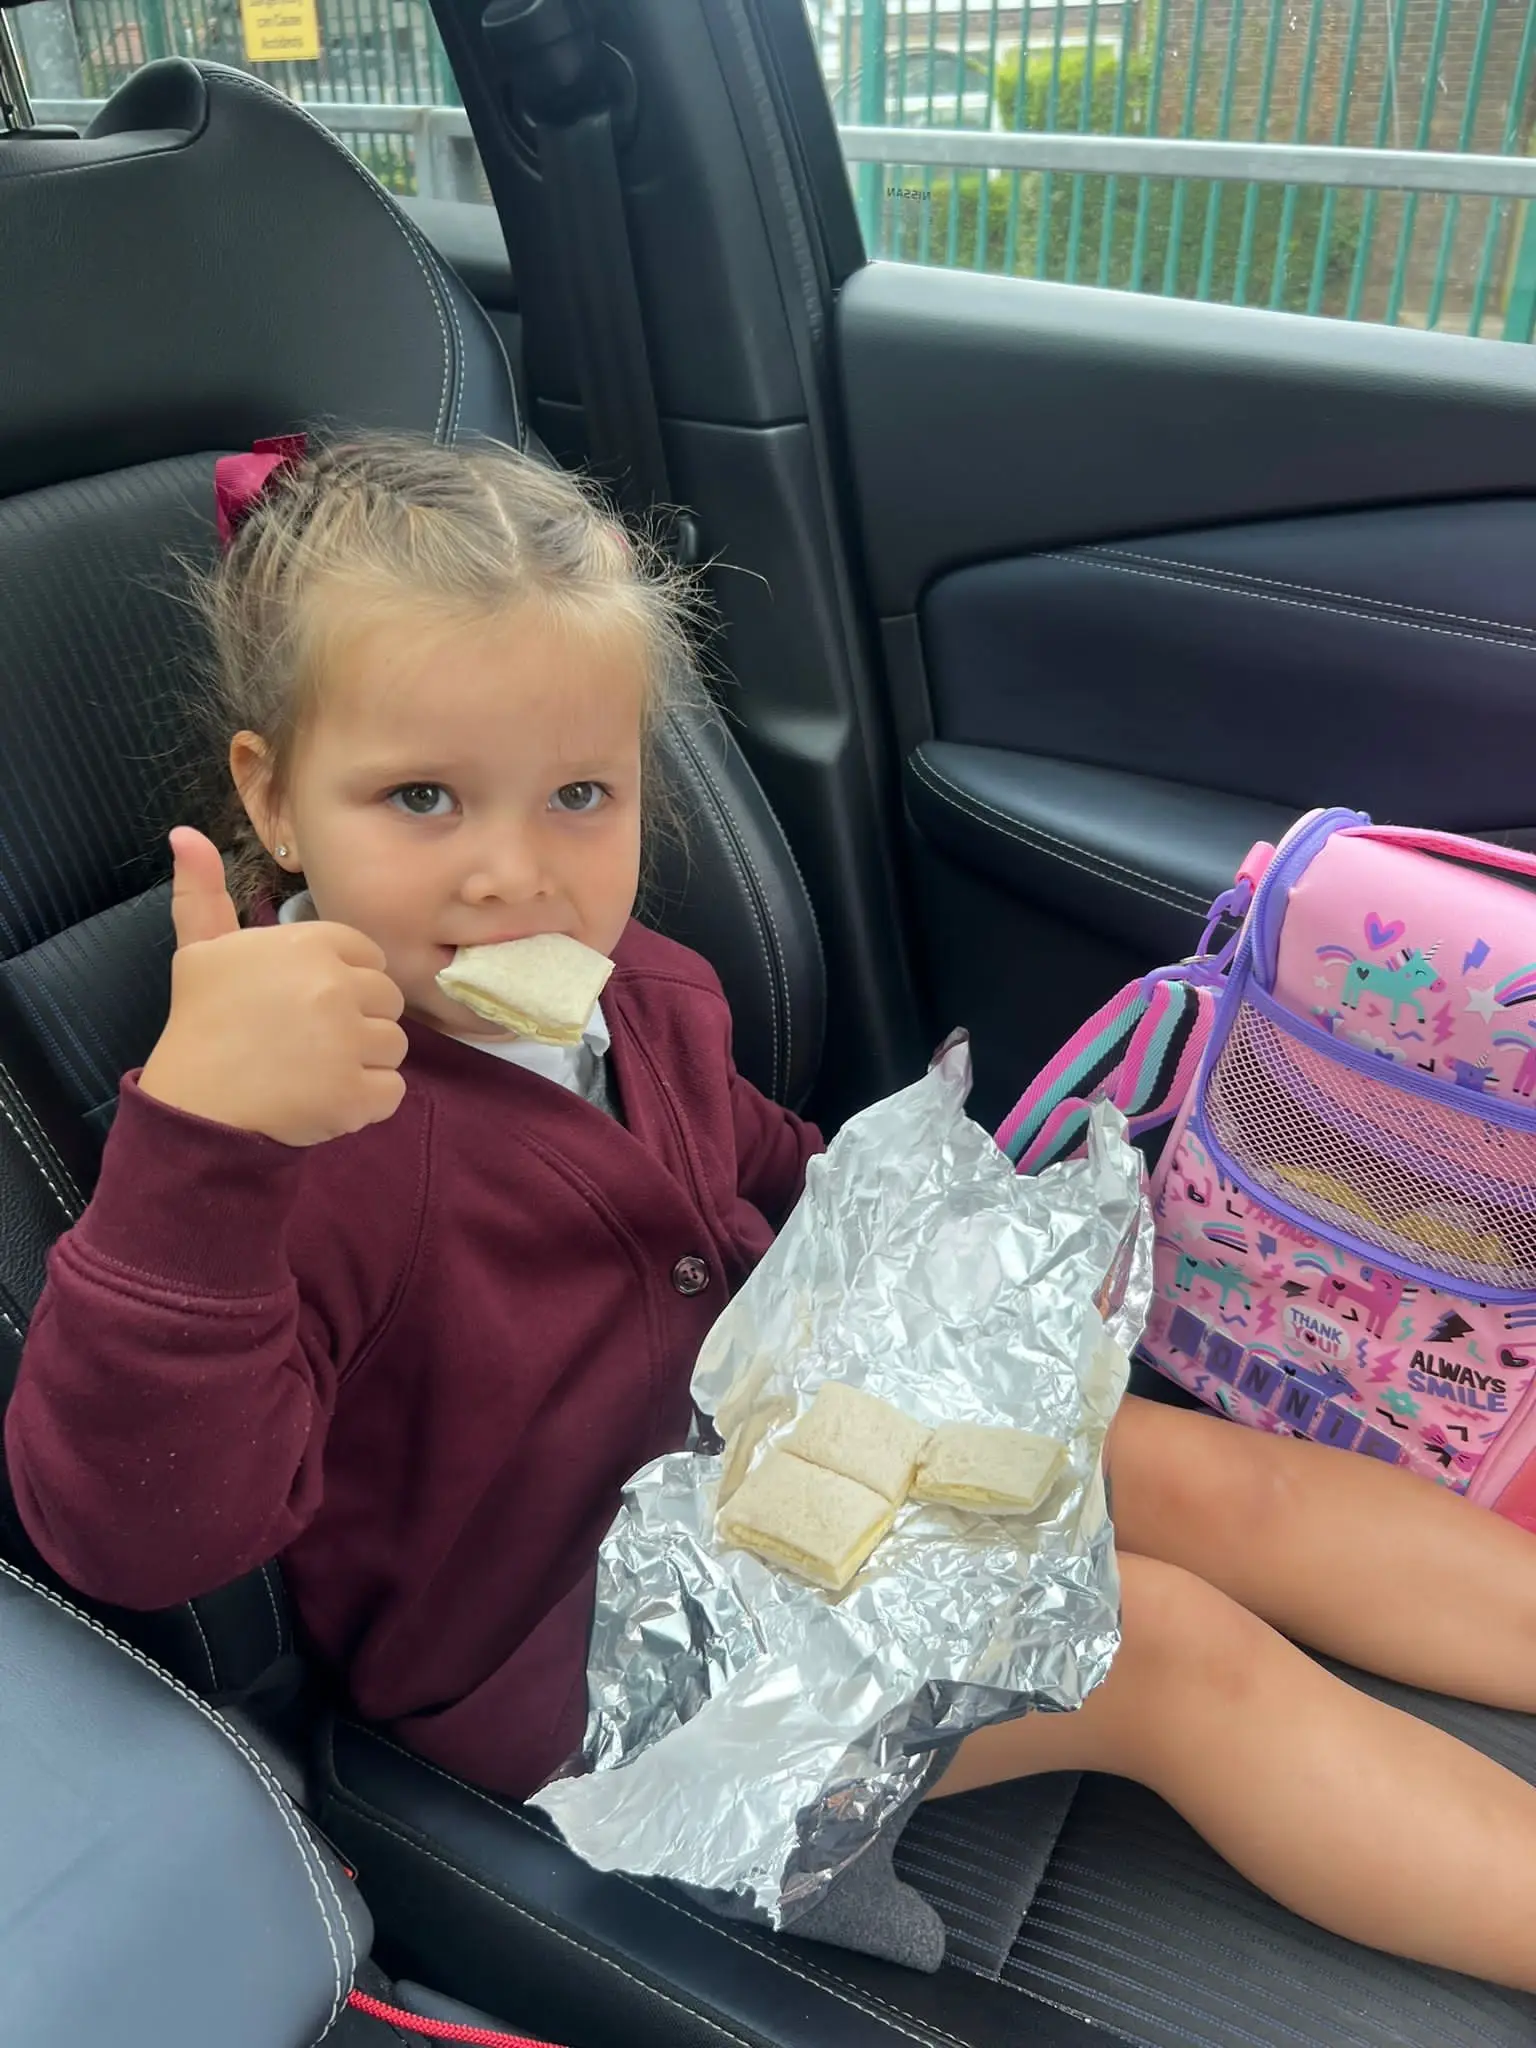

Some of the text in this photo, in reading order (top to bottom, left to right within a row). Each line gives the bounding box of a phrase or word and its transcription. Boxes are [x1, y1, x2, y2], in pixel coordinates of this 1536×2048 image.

[1290, 1307, 1343, 1345] THANK
[1292, 1322, 1339, 1357] YOU!
[1407, 1370, 1508, 1412] SMILE
[1409, 1349, 1508, 1394] ALWAYS
